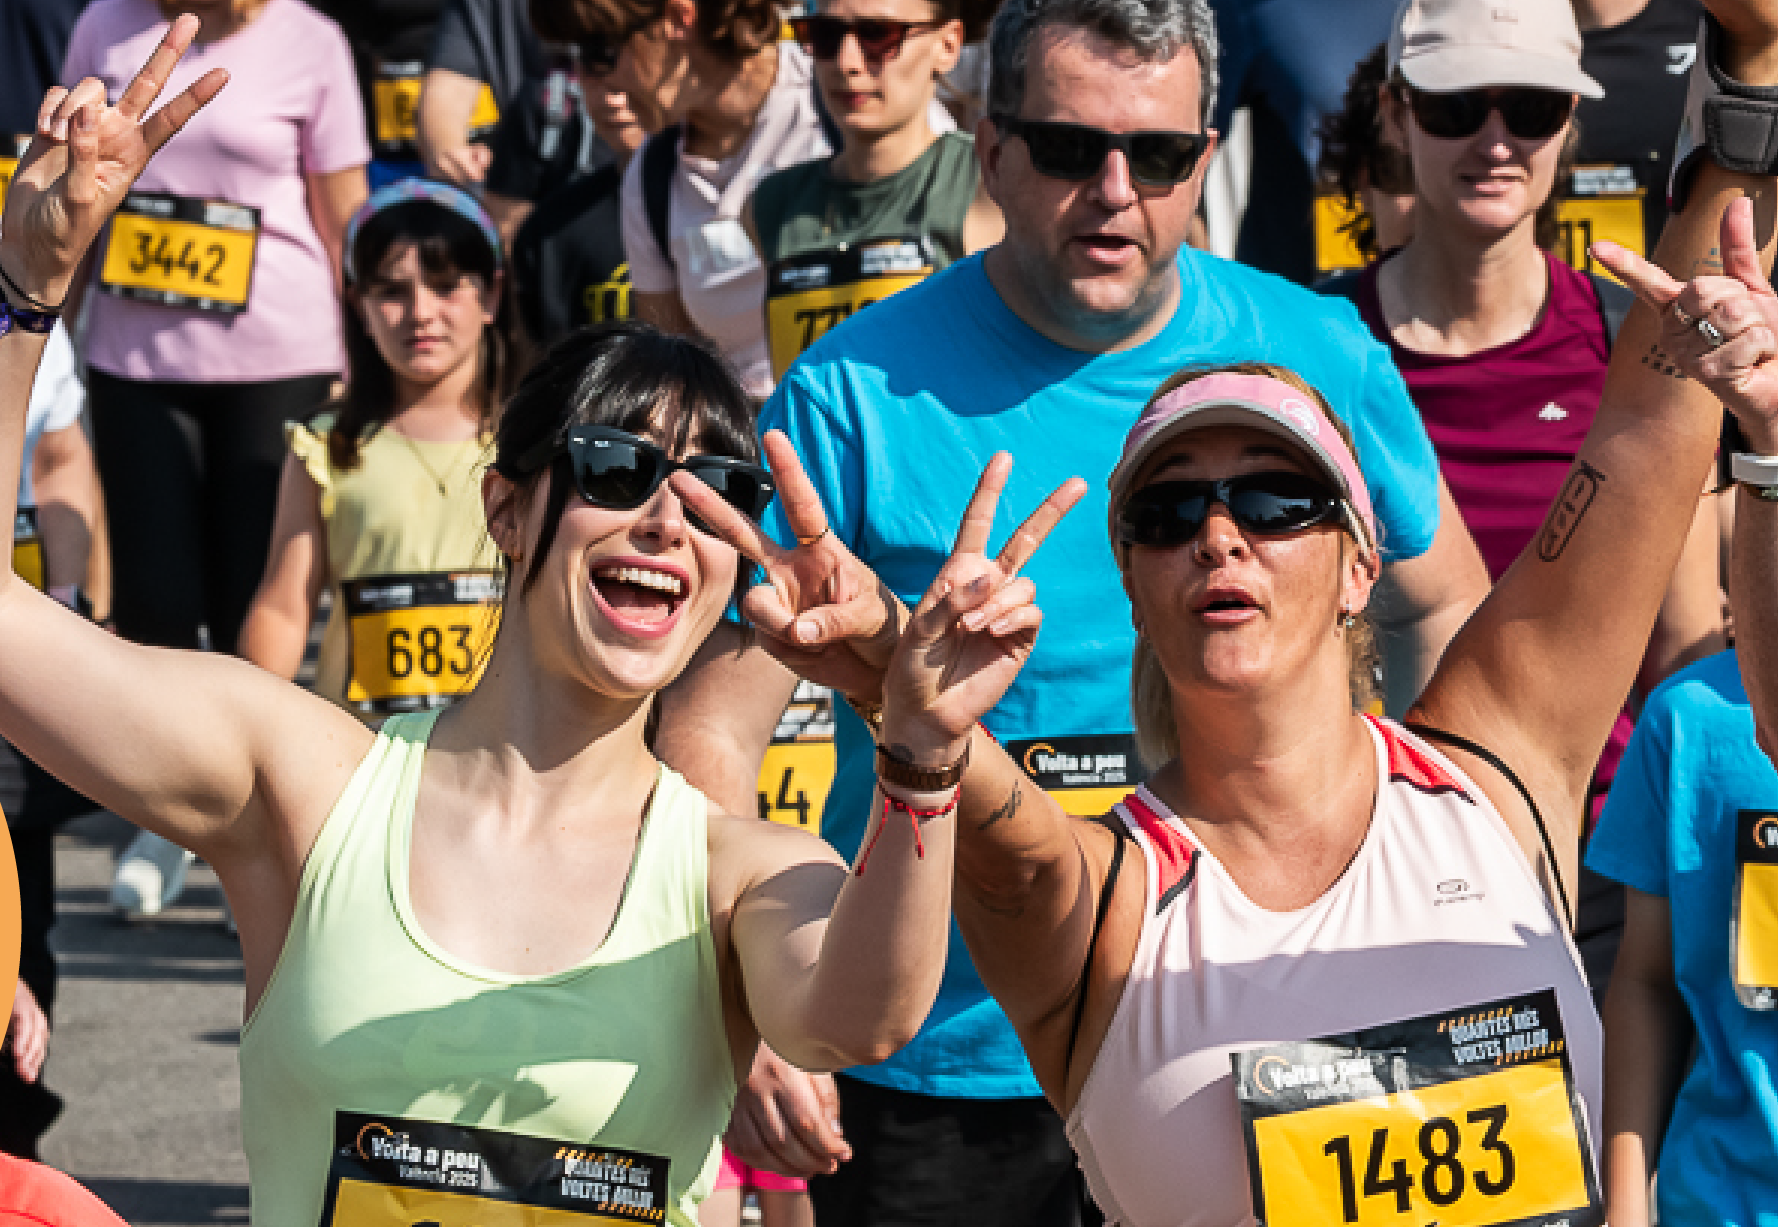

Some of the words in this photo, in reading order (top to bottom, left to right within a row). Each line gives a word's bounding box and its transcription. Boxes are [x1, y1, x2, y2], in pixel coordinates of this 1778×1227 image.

[128, 231, 227, 288] 3442
[386, 625, 474, 678] 683
[1323, 1104, 1516, 1223] 1483
